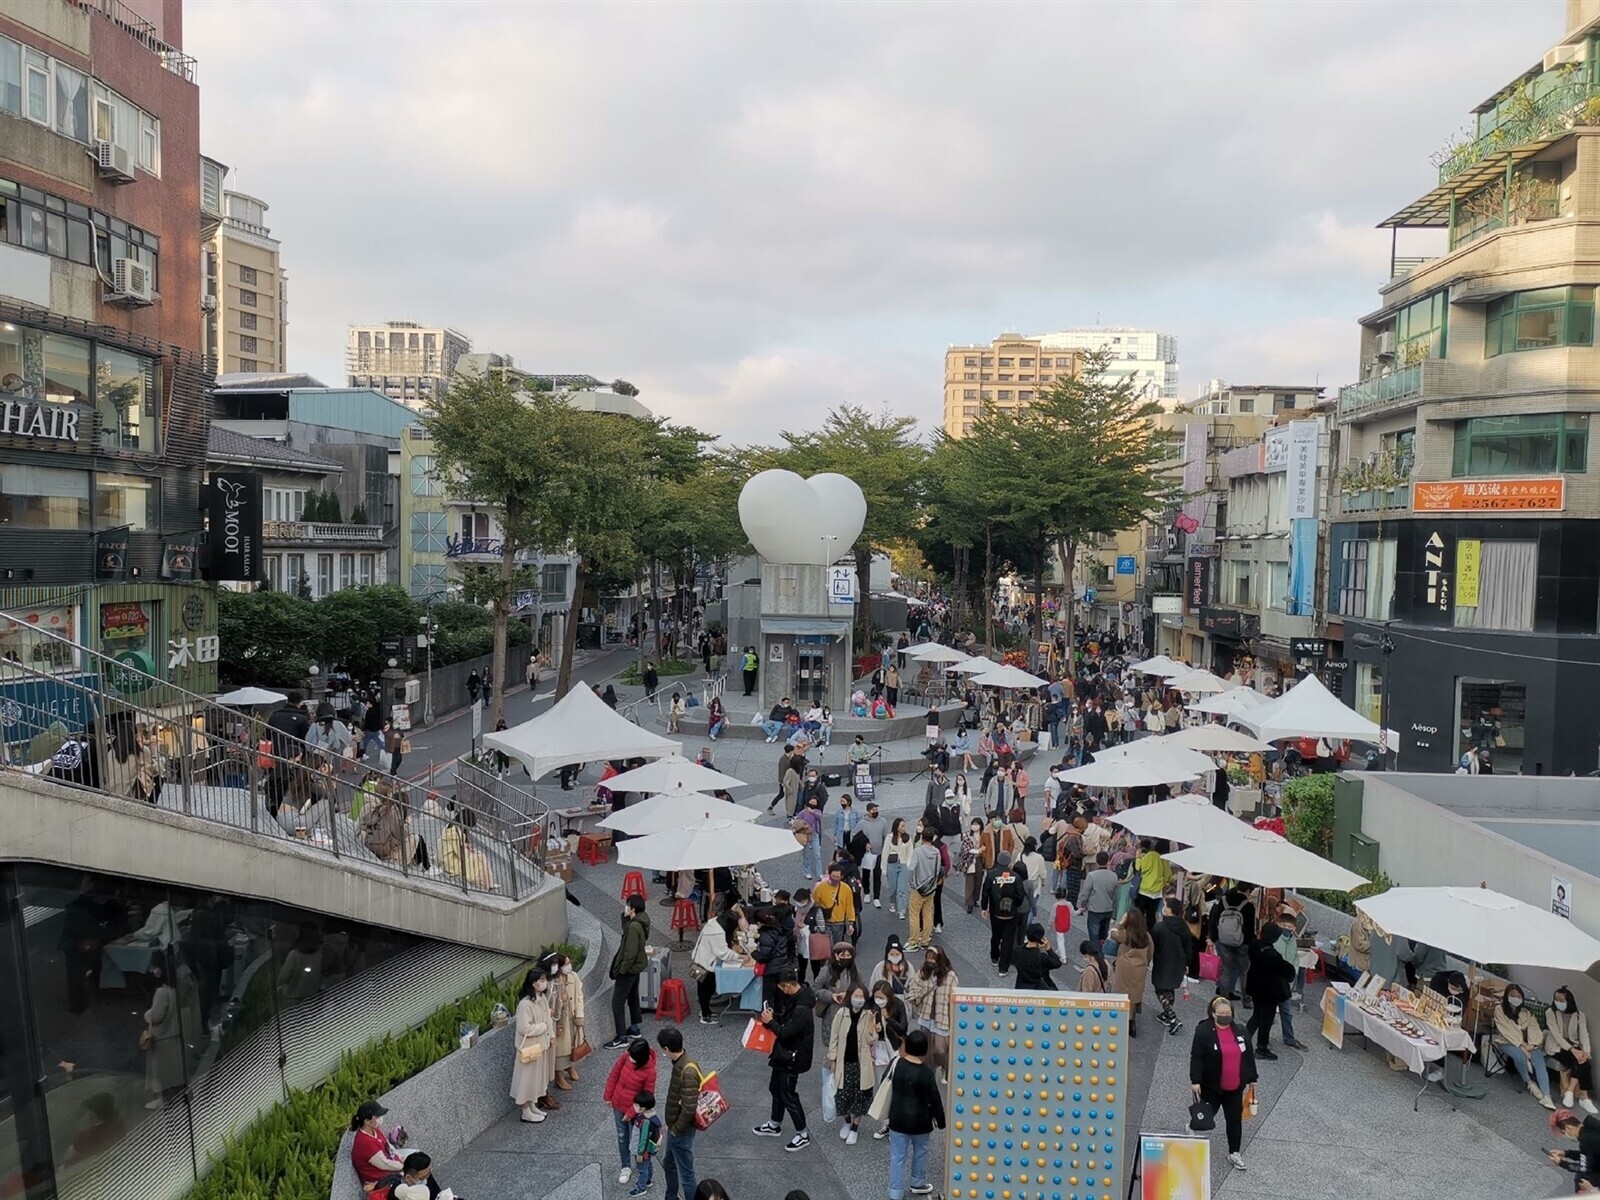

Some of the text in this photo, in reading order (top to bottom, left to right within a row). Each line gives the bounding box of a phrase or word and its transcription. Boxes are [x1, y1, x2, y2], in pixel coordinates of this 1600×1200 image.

[1, 401, 79, 441] HAIR
[1472, 498, 1557, 509] 2567-7627
[224, 510, 239, 554] MOOI
[1193, 561, 1203, 605] aimerfeel
[1425, 531, 1444, 603] ANTI
[1440, 579, 1448, 611] SALON
